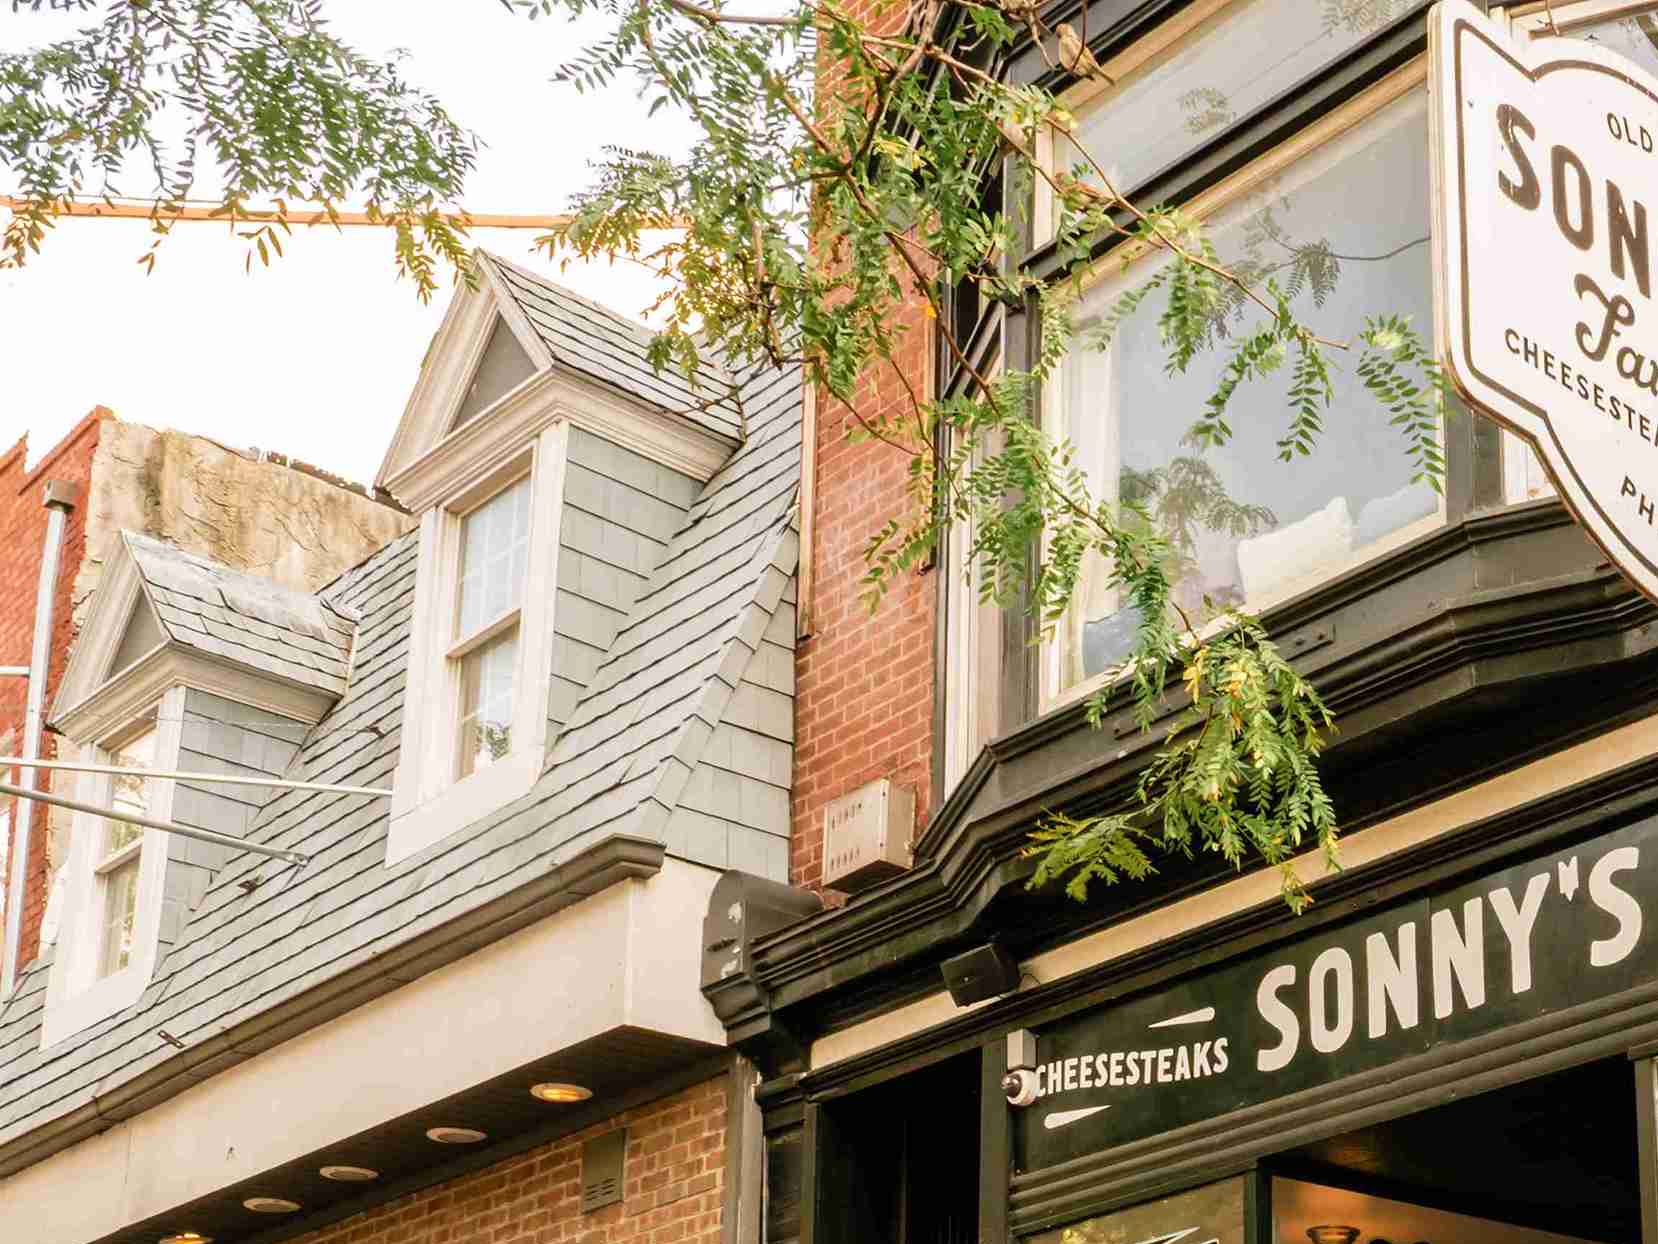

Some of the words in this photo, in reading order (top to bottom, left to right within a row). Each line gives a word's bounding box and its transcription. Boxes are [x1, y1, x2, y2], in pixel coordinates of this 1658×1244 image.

[1606, 111, 1654, 155] OLD
[1256, 846, 1642, 1072] SONNY'S
[1035, 1036, 1230, 1097] CHEESESTEAKS
